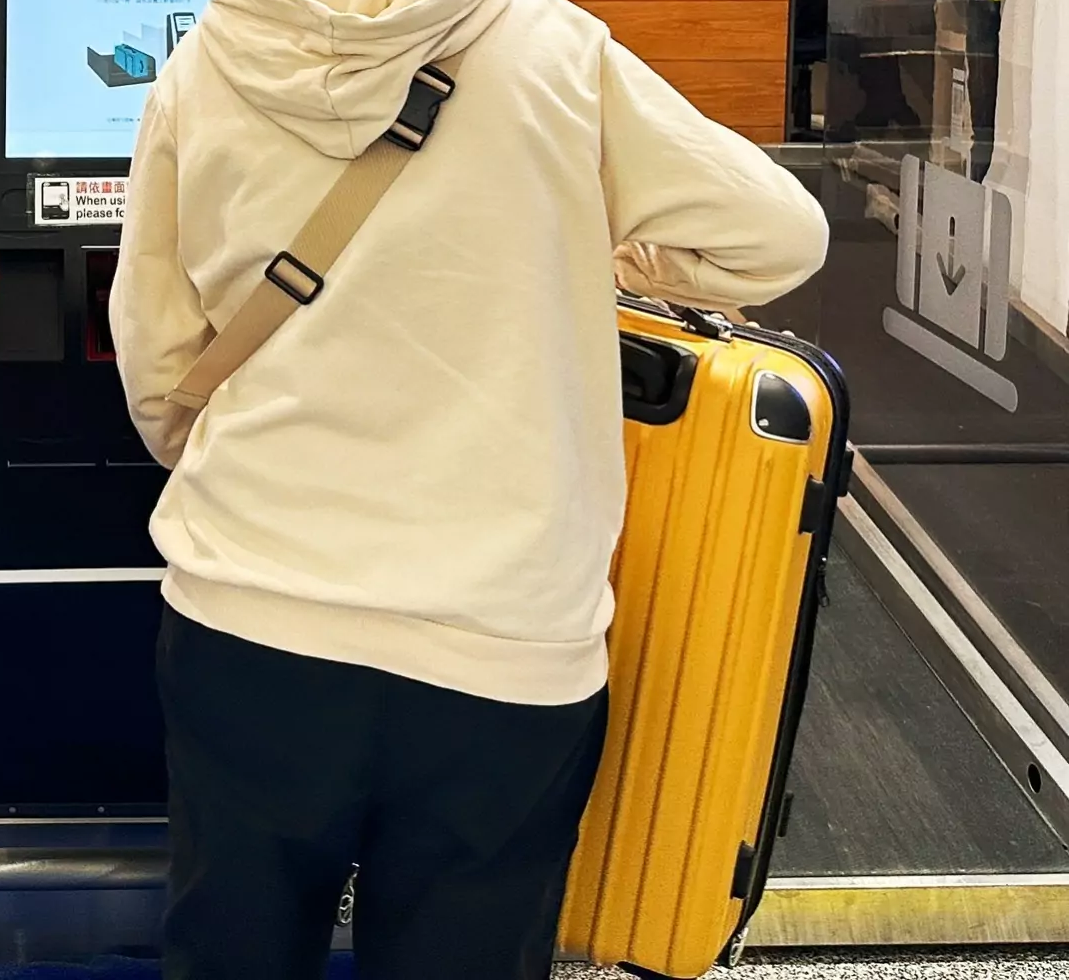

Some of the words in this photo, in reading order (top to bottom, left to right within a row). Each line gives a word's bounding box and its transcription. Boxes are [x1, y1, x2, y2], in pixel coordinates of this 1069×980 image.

[76, 181, 128, 194] 請依畫面
[76, 195, 107, 205] When
[110, 196, 125, 205] usi
[76, 208, 112, 220] please
